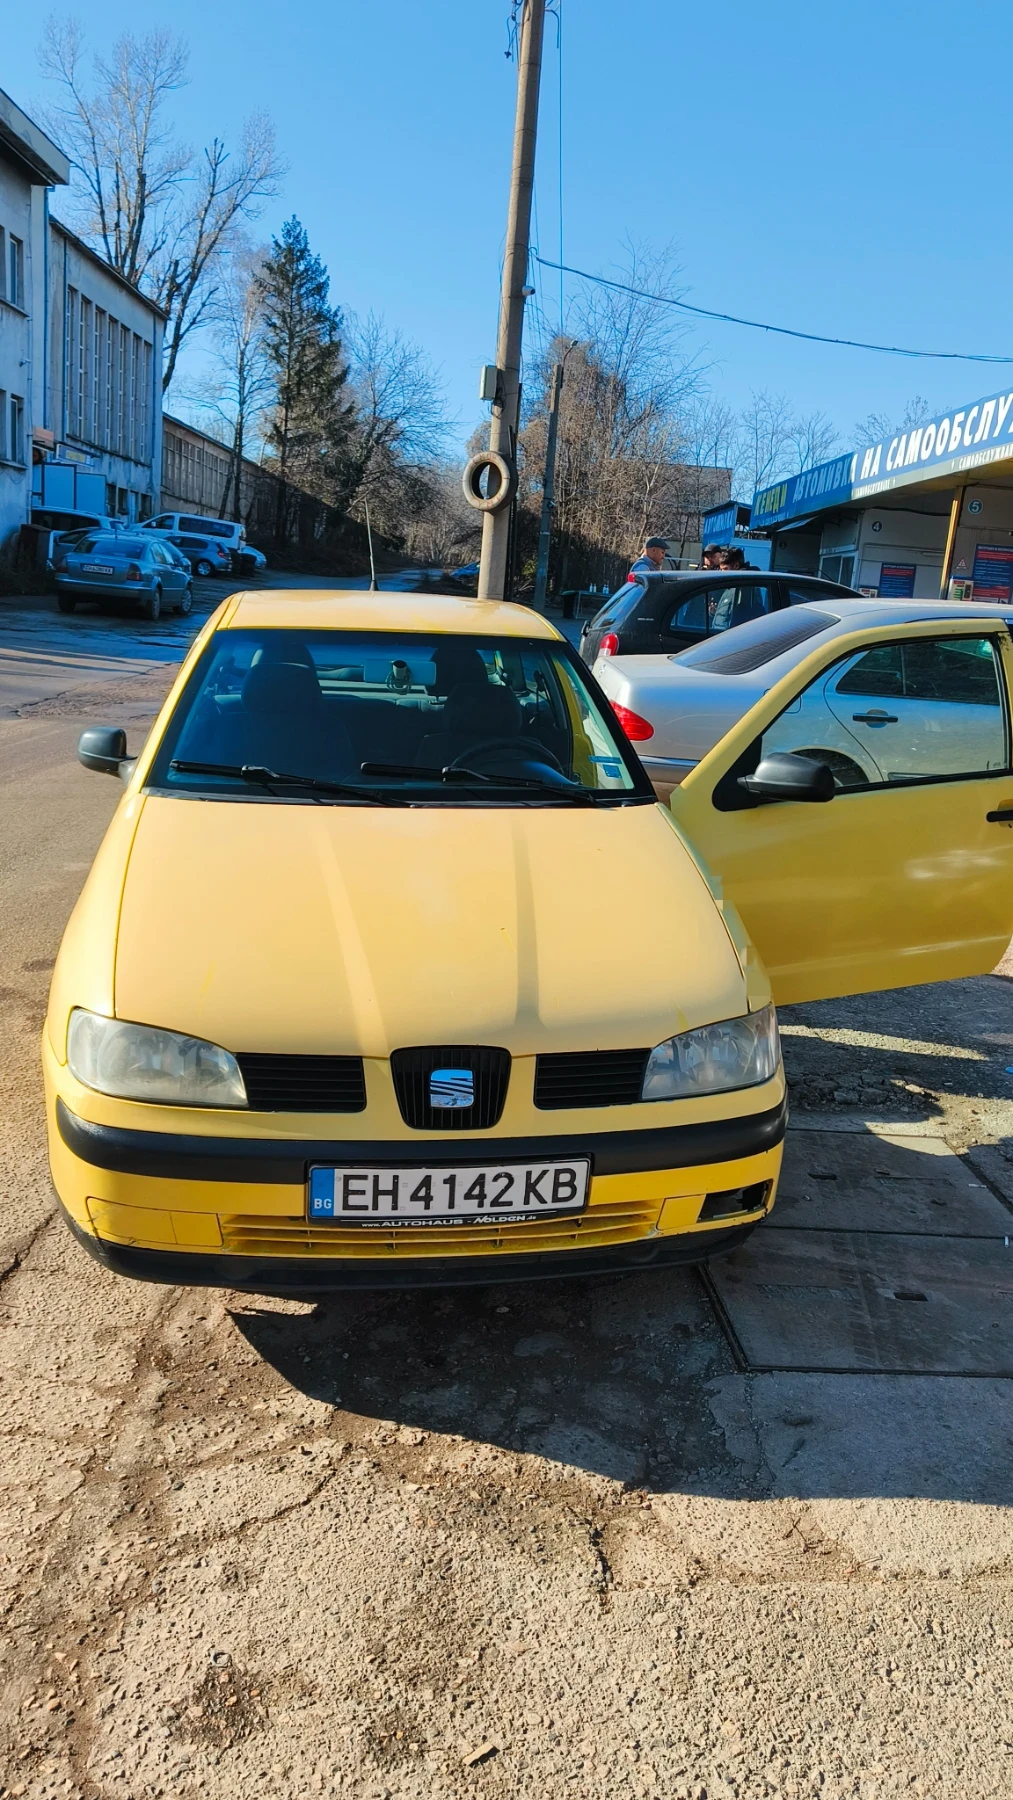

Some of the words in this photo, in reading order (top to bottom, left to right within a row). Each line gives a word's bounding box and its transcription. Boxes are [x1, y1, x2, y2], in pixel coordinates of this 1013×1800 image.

[754, 483, 788, 516] КЕНЕДИ
[792, 453, 858, 503] АВТОМИВКА
[860, 444, 882, 480] НА
[886, 392, 1013, 472] САМООБСЛУ
[971, 500, 980, 512] 5
[872, 521, 881, 532] 4
[314, 1198, 332, 1209] BG
